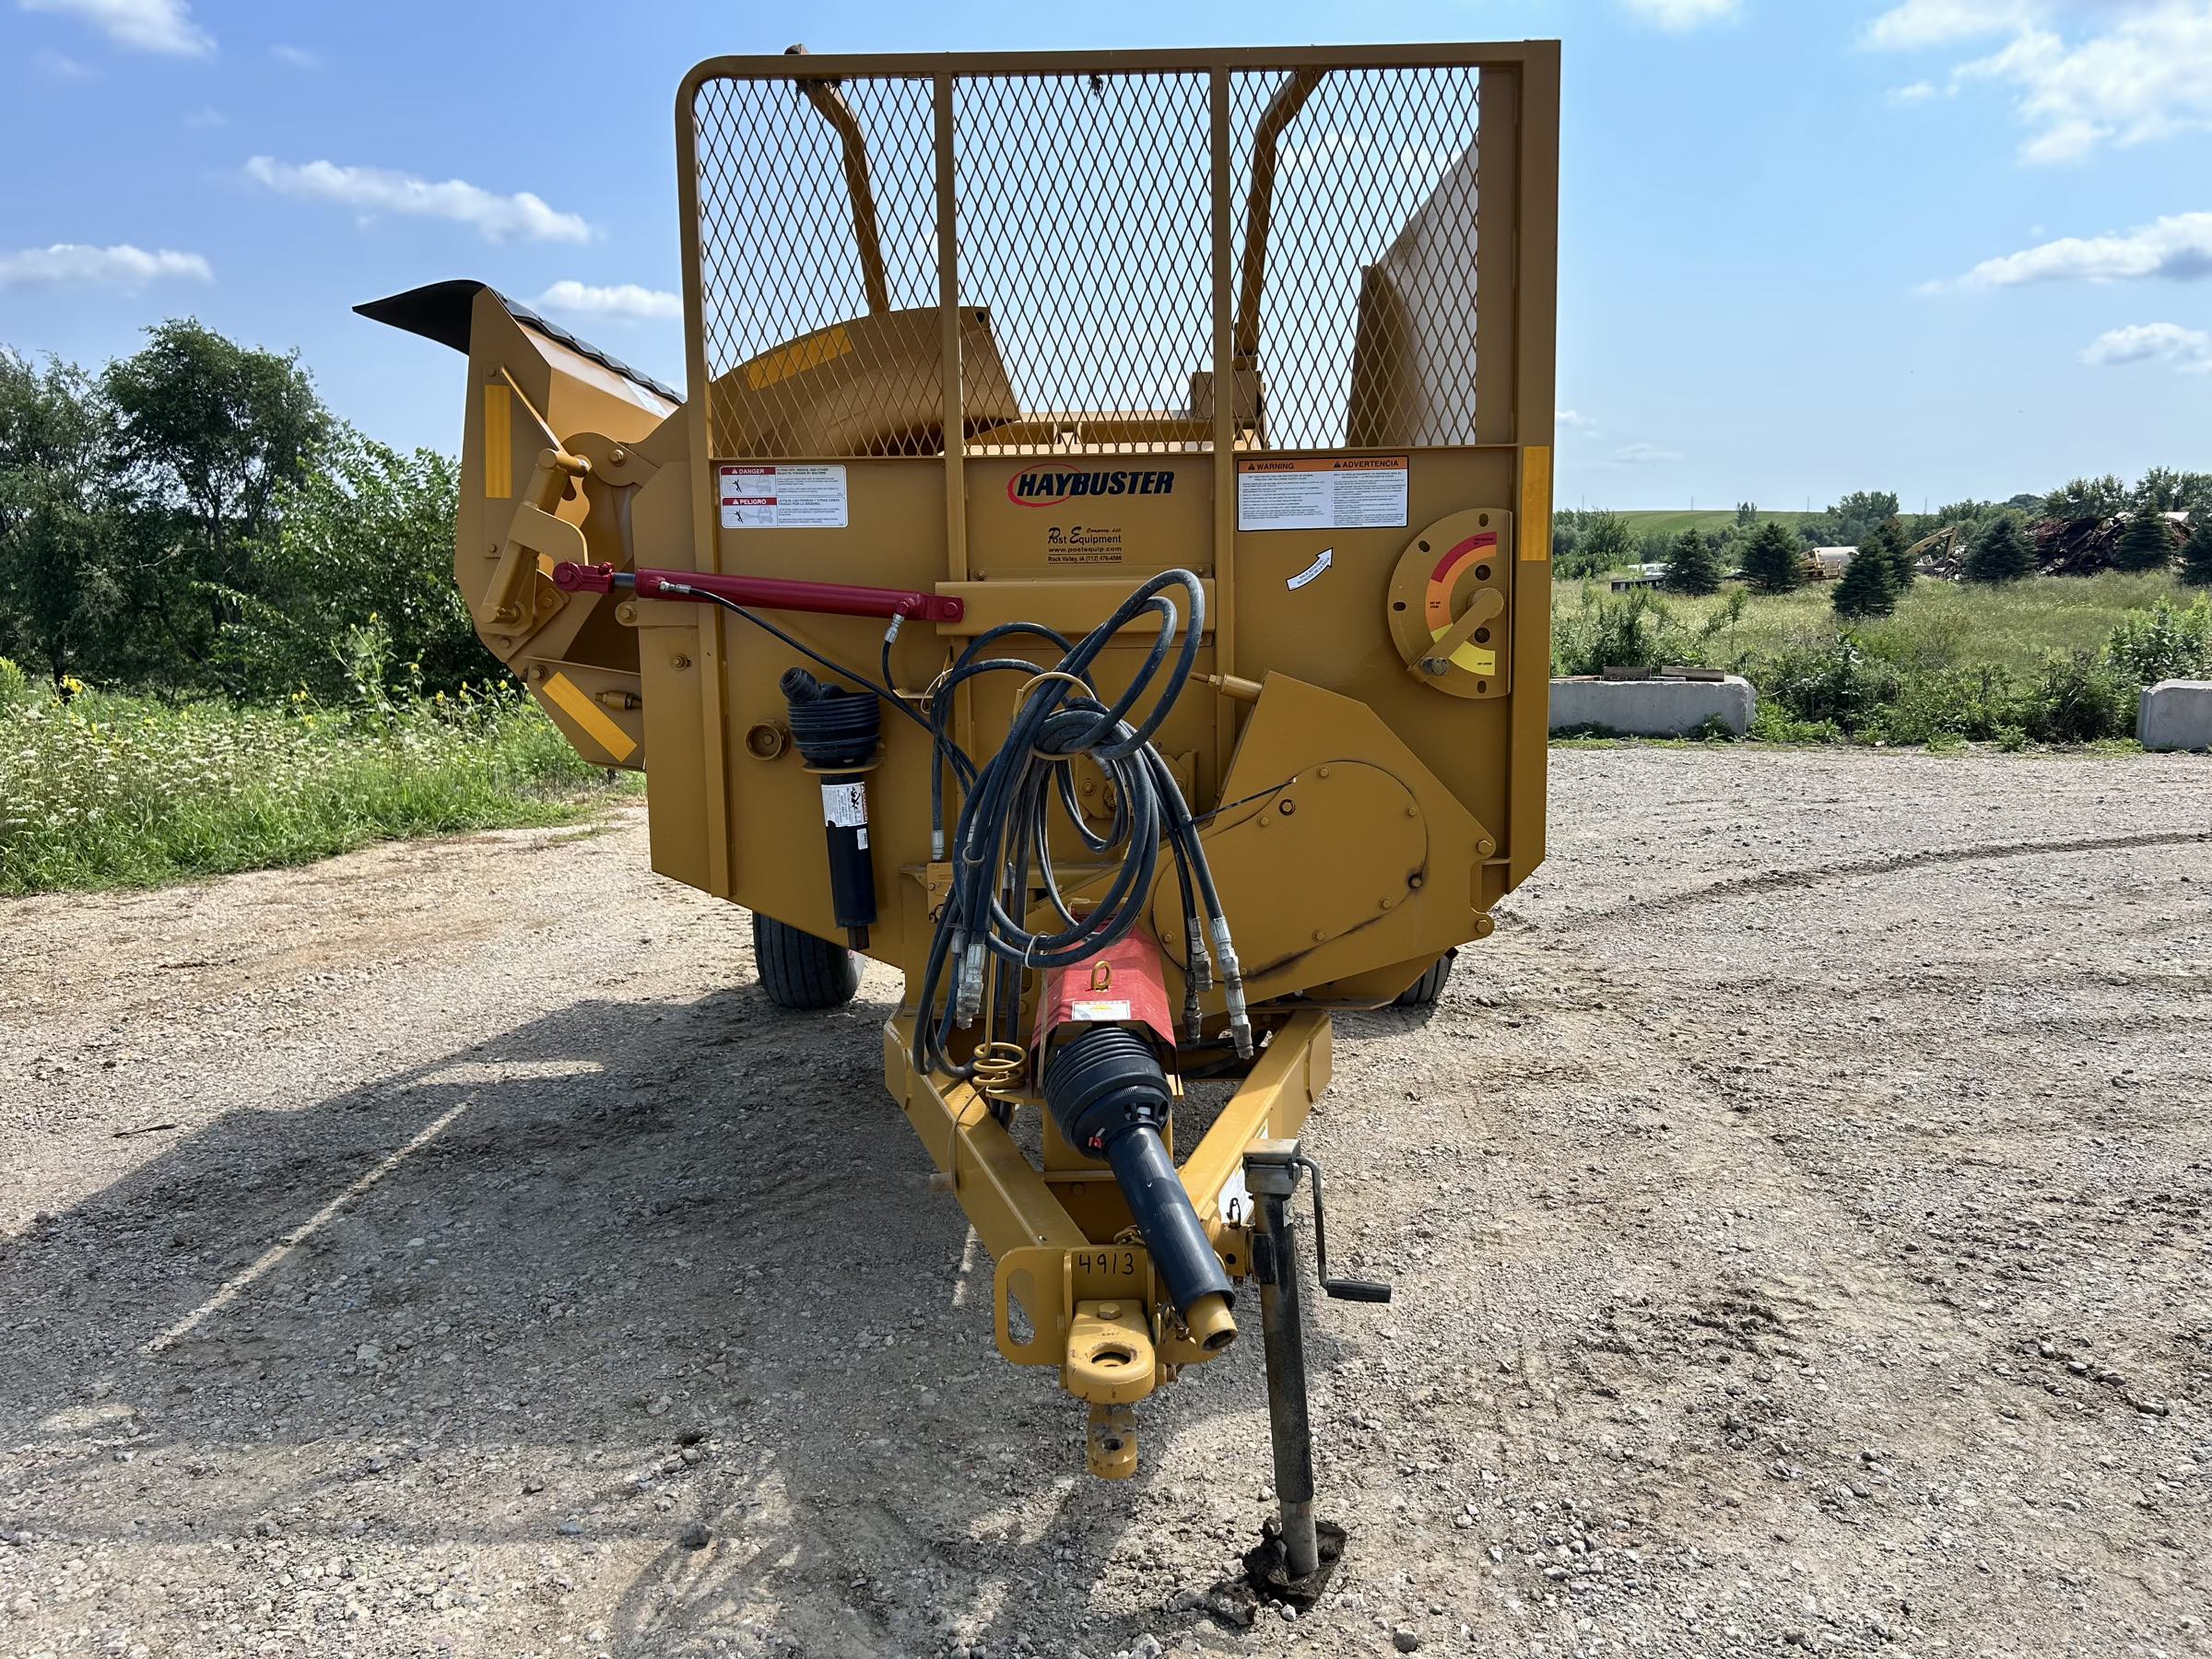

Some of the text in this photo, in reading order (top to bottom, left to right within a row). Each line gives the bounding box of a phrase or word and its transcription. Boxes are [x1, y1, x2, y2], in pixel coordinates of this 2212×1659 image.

[1342, 460, 1399, 468] ADVERTENCIA
[1017, 471, 1175, 497] HAYBUSTER
[1048, 526, 1122, 545] Post Equipment
[1078, 1253, 1135, 1276] 4913
